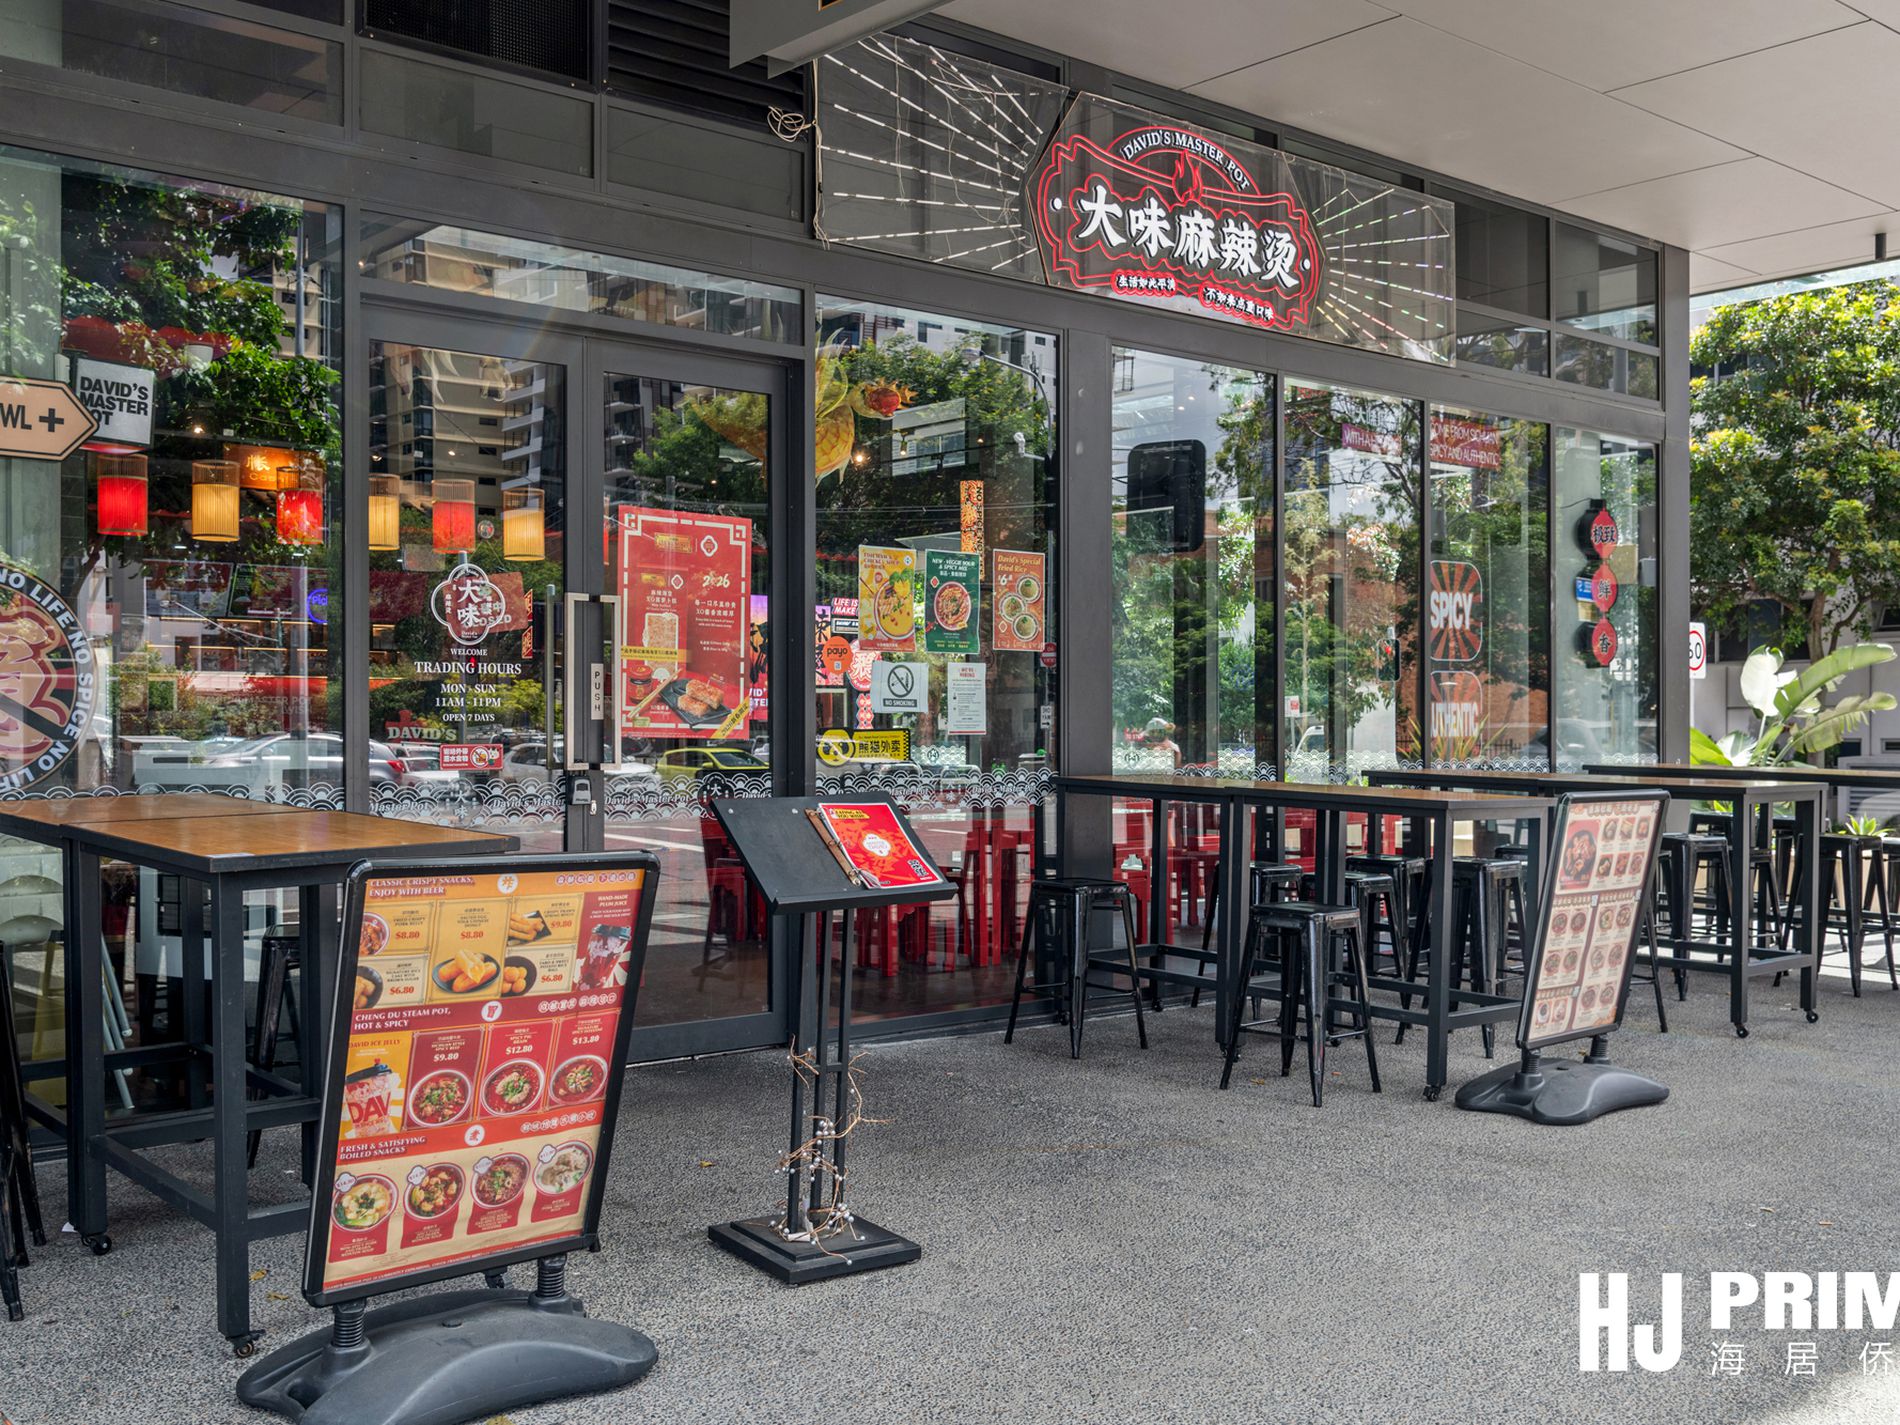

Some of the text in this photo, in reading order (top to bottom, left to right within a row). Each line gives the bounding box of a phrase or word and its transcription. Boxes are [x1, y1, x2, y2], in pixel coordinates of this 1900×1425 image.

[1120, 130, 1250, 191] DAVID'S MASTER POT
[1075, 184, 1300, 288] 大味麻辣烫
[79, 376, 149, 401] DAVID'S
[79, 392, 149, 416] MASTER
[29, 584, 75, 629] LIFE
[457, 579, 483, 628] 大味
[833, 598, 850, 606] LIFE
[1430, 589, 1473, 630] SPICY
[68, 628, 91, 665] NO
[1598, 633, 1611, 653] 香
[450, 648, 488, 656] WELCOME
[414, 661, 522, 675] TRADING HOURS
[440, 683, 497, 693] MON SUN
[593, 671, 601, 712] PUSH
[63, 672, 95, 741] SPICE
[434, 697, 465, 707] 11AM
[472, 697, 502, 708] 11PM
[885, 699, 916, 707] NO SMOKING
[442, 713, 466, 721] OPEN
[474, 713, 496, 722] DAYS
[1430, 701, 1479, 738] UTHENTIC
[386, 726, 457, 741] DAVID'S
[38, 739, 70, 771] NO
[410, 801, 430, 811] Pot
[493, 799, 530, 809] David's
[604, 793, 690, 806] David's Master Pot
[370, 876, 475, 888] CLASSIC CRISPY SNACKS,
[369, 886, 445, 898] ENJOY WITH BEER
[550, 919, 573, 929] $9.80
[395, 930, 420, 940] $8.80
[460, 930, 484, 940] $8.80
[541, 973, 564, 983] $6.80
[389, 986, 415, 995] $6.80
[355, 1007, 452, 1022] CHENG DU STEAM POT,
[354, 1018, 410, 1031] HOT & SPICY
[369, 1039, 383, 1047] ICE
[383, 1038, 401, 1046] JELLY
[572, 1034, 601, 1046] $13.80
[505, 1044, 534, 1056] $12.80
[433, 1052, 460, 1063] $9.80
[340, 1135, 427, 1154] FRESH & SATISFYING
[340, 1145, 407, 1160] BOILED SNACKS
